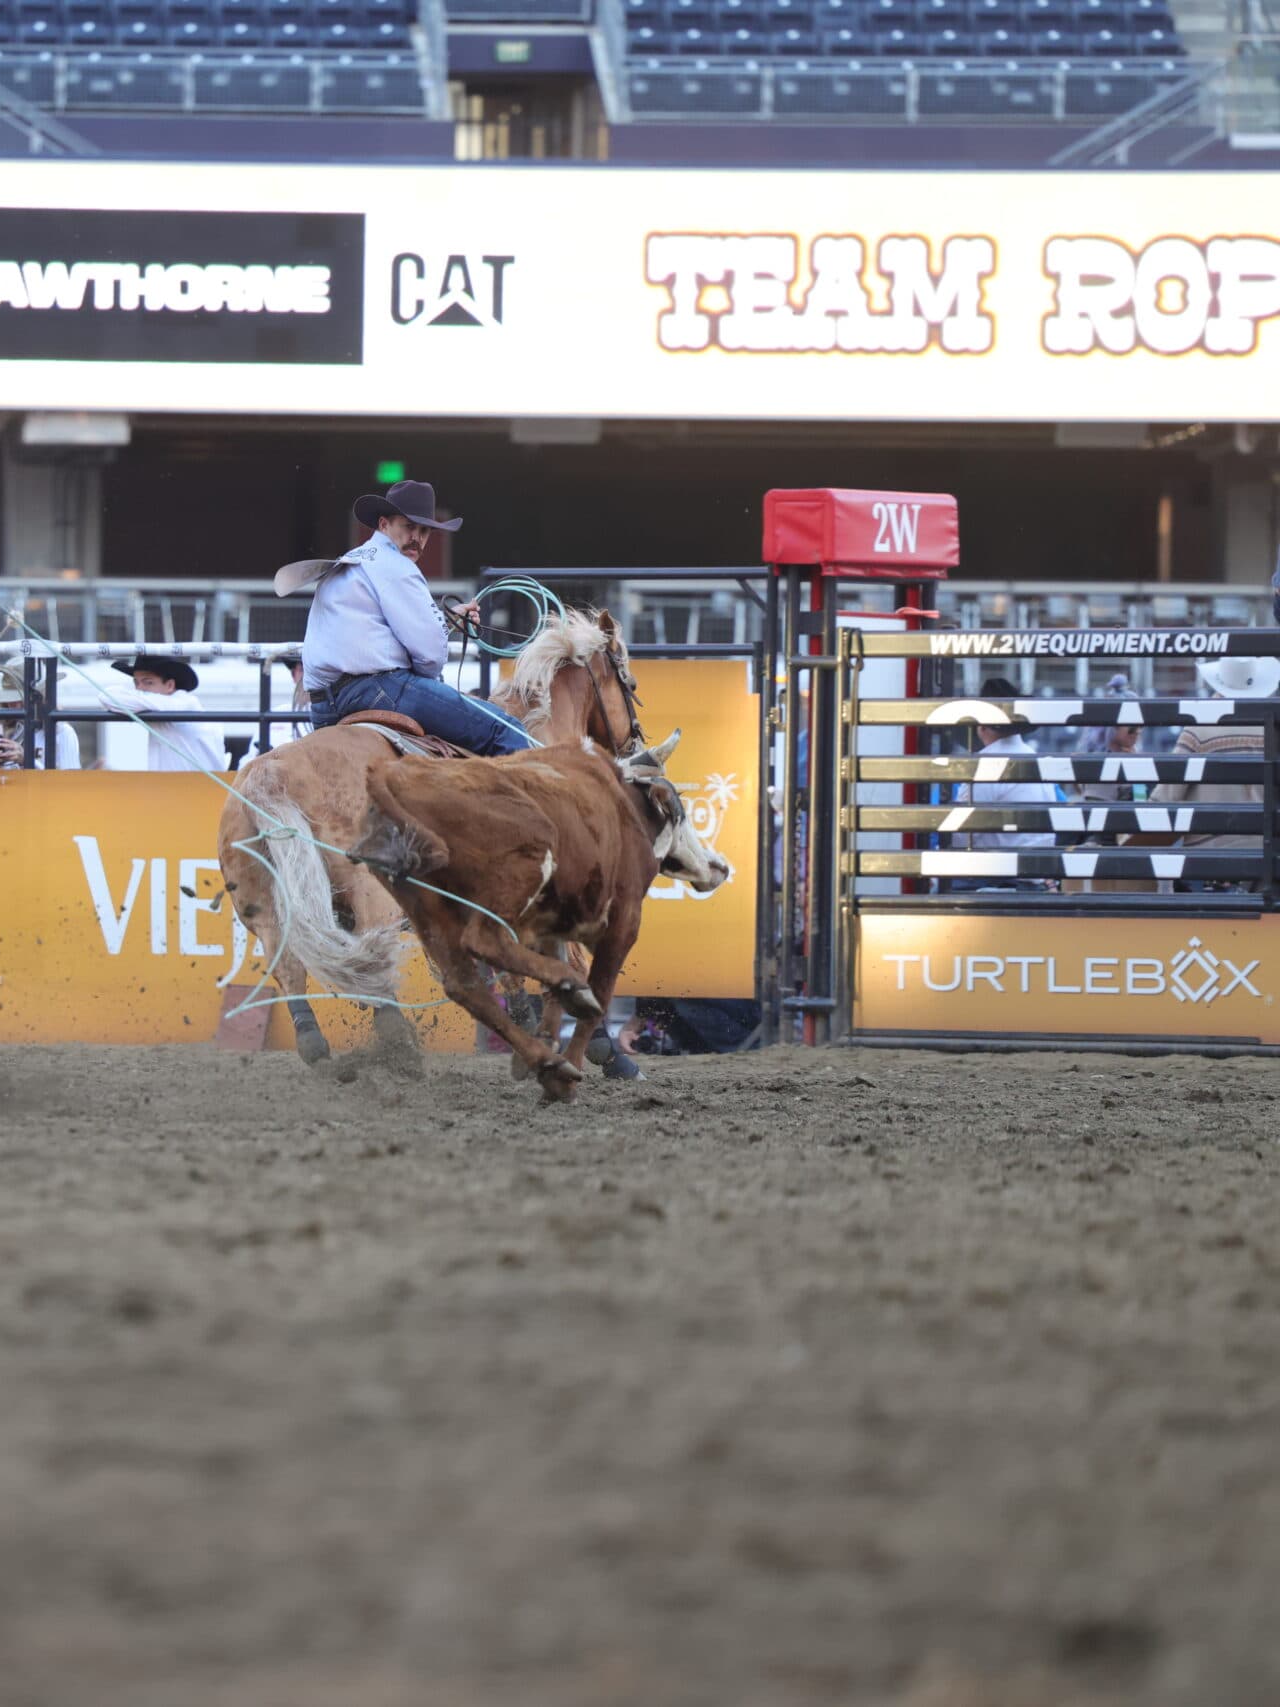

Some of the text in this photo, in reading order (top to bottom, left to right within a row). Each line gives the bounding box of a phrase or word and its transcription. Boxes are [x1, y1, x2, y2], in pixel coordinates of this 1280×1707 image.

[390, 252, 516, 327] CAT
[644, 231, 1280, 356] TEAM ROP
[872, 502, 922, 554] 2W
[930, 633, 1229, 656] WWW.2WEQUIPMENT.COM
[882, 937, 1263, 1003] TURTLEBOX
